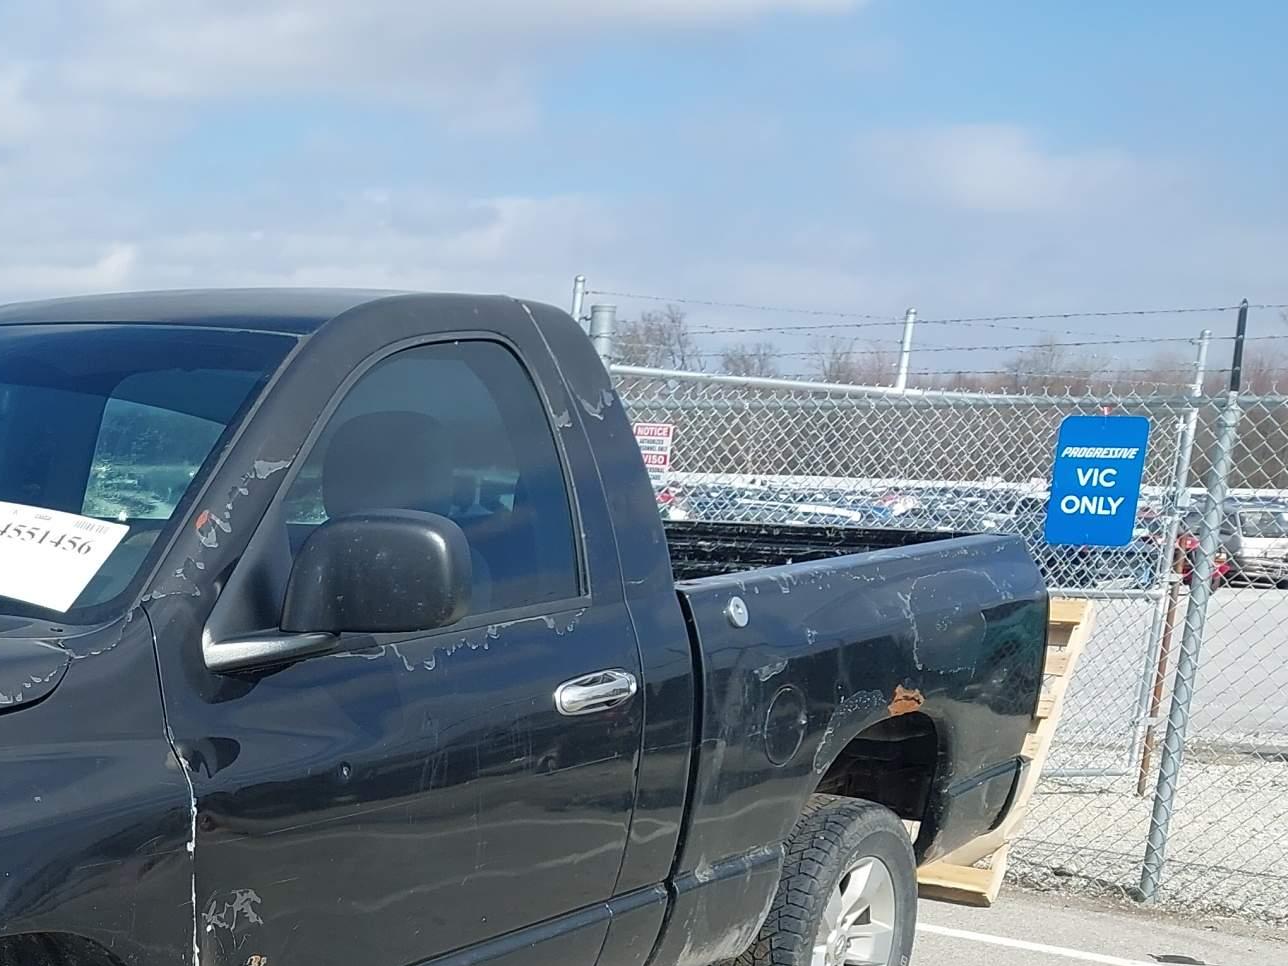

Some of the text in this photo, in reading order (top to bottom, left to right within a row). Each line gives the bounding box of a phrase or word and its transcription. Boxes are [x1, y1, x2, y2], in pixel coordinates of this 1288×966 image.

[636, 425, 669, 436] NOTICE
[643, 453, 665, 465] VISO
[1061, 446, 1140, 459] PROGRESSIVE
[1076, 468, 1118, 487] VIC
[1060, 495, 1125, 515] ONLY
